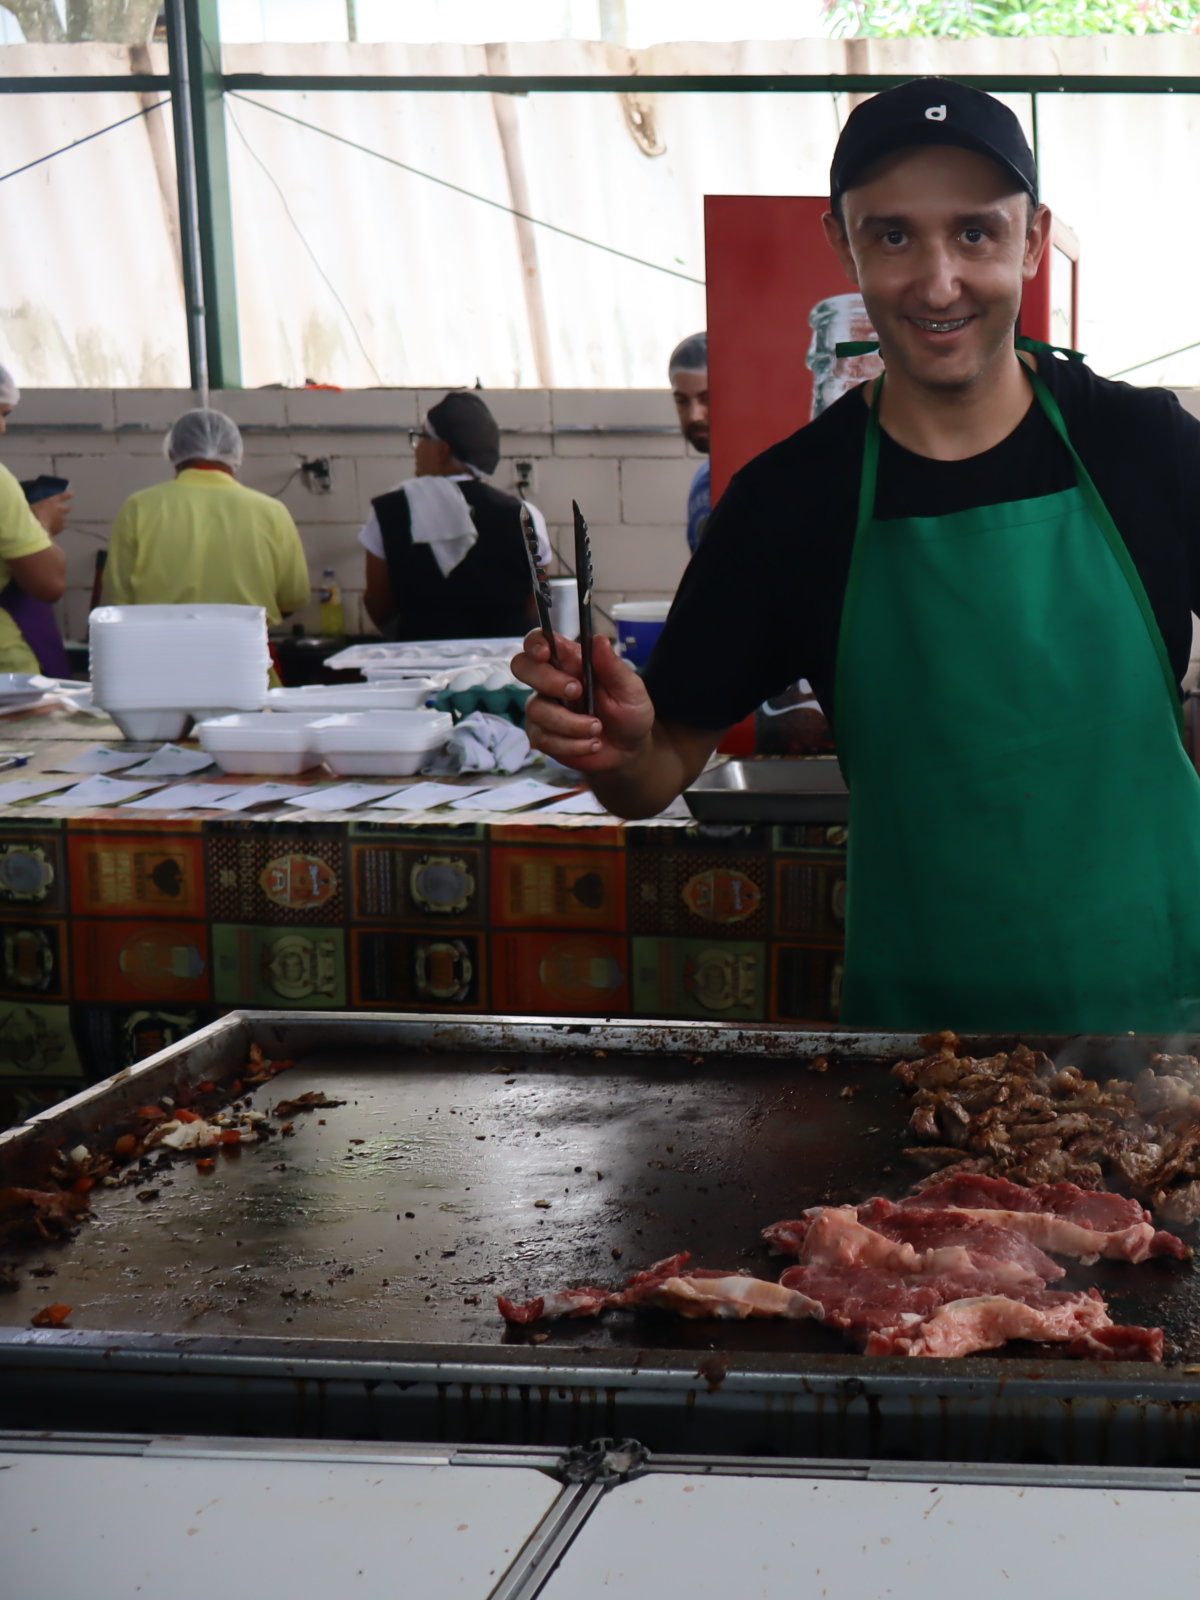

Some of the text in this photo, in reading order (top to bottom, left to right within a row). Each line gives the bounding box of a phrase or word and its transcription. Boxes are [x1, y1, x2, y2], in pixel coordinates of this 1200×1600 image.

[925, 104, 947, 122] d
[117, 852, 132, 901] SPECIAL
[539, 865, 554, 914] SPECIAL
